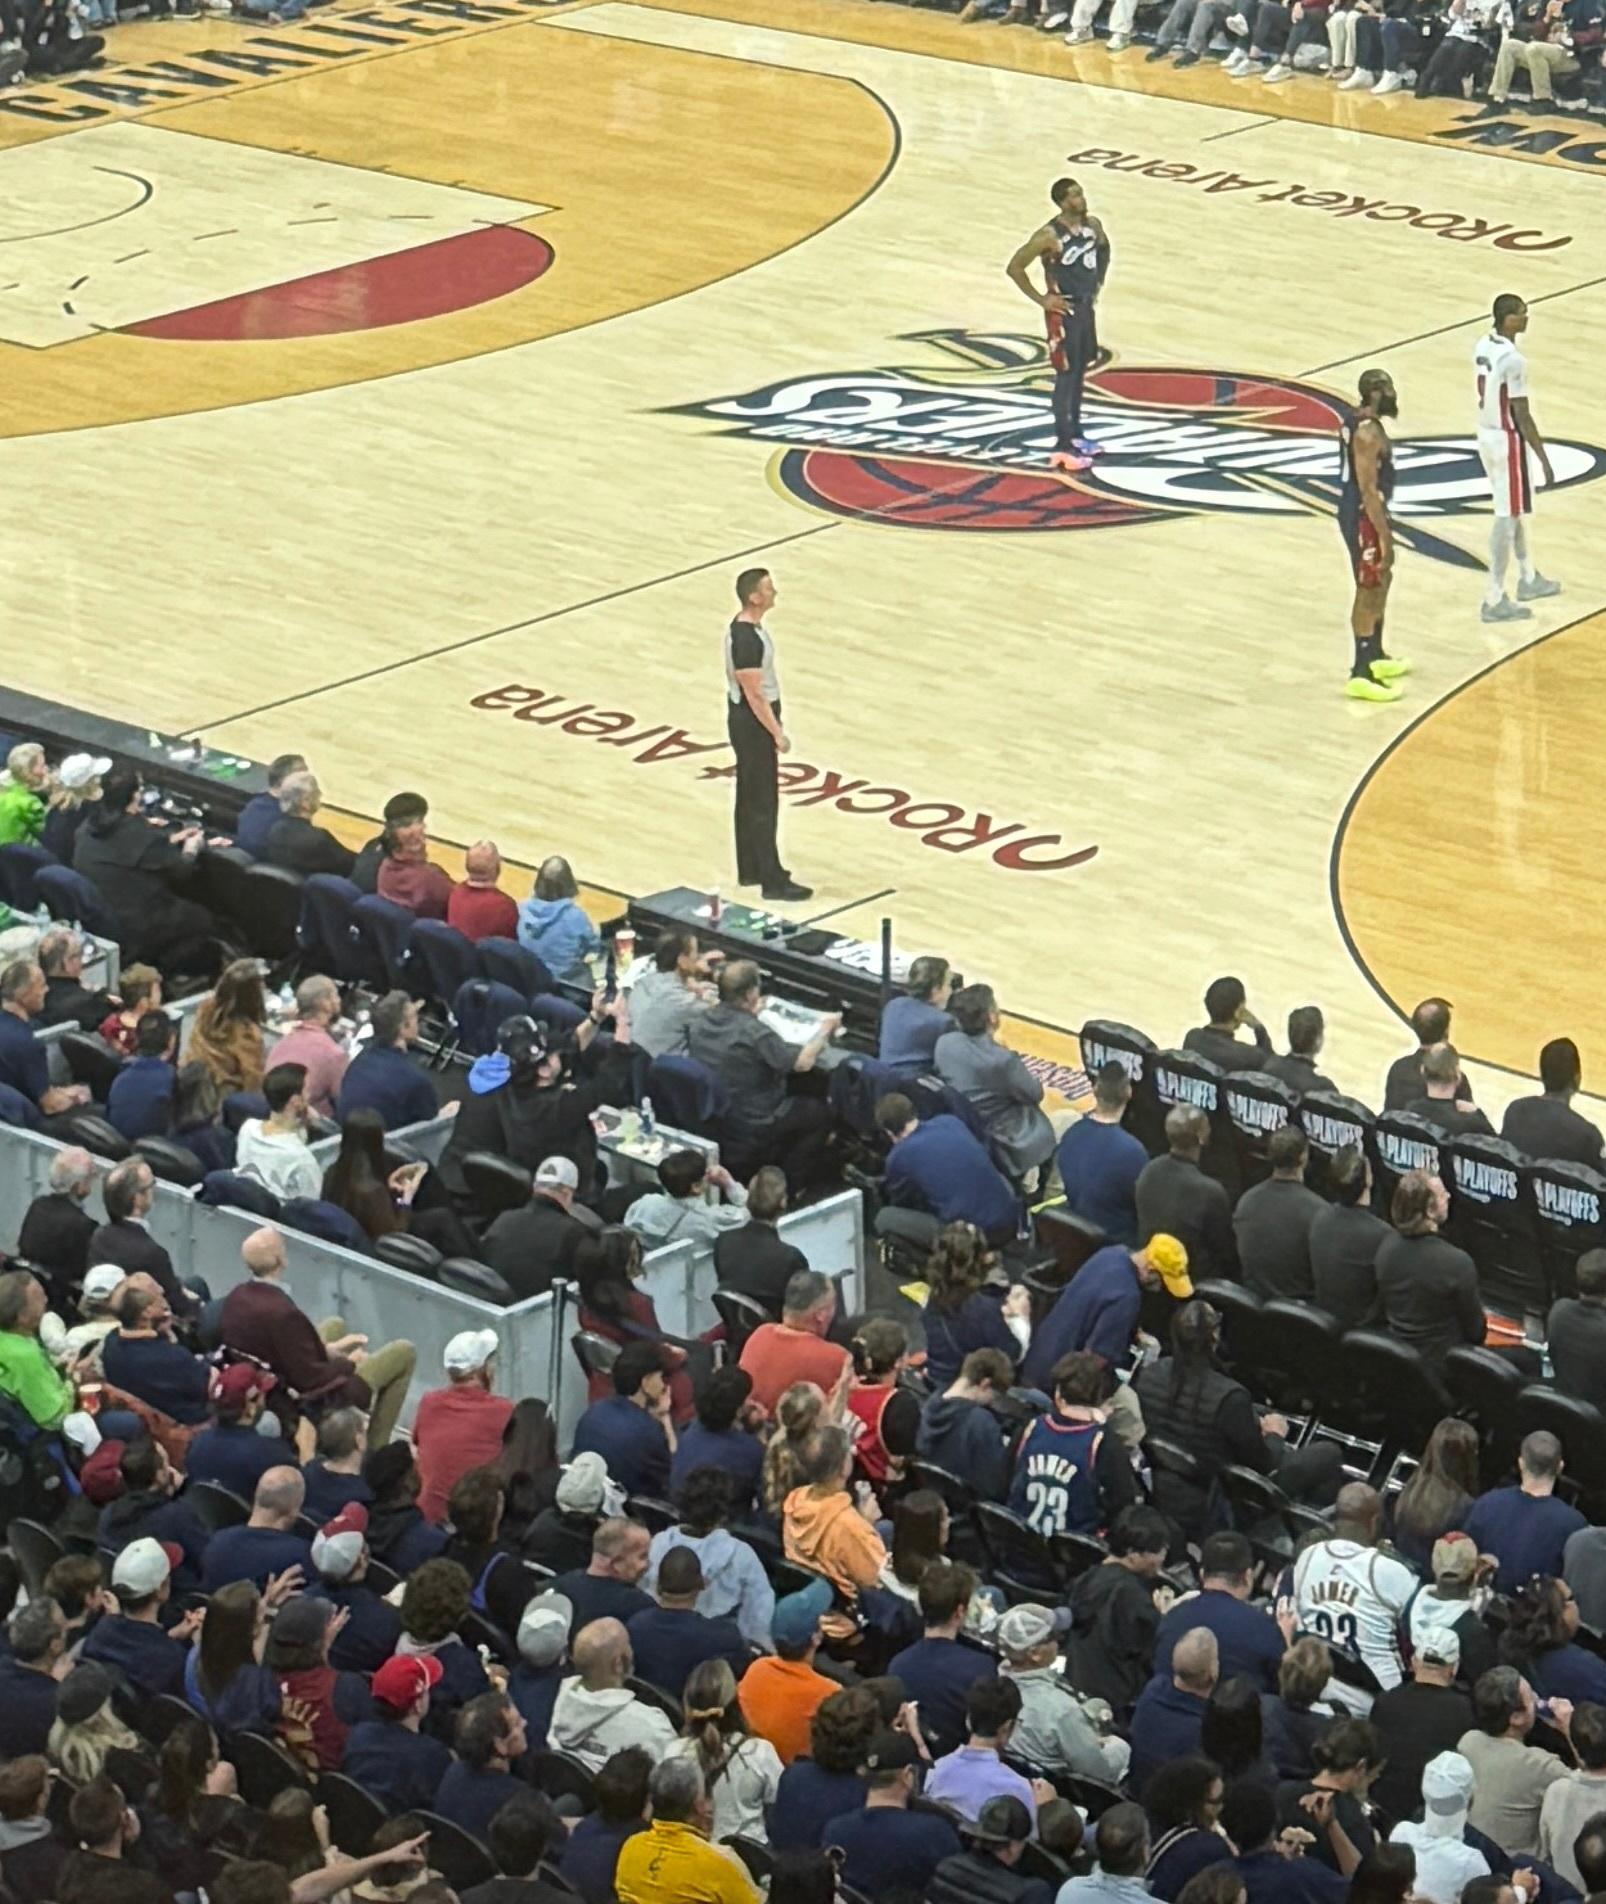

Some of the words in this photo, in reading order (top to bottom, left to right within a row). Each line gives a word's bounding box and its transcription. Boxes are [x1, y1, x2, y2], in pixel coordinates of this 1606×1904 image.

[1066, 146, 1258, 206] Arena
[1258, 188, 1504, 248] Rocket
[470, 683, 730, 765] Arena
[1027, 1453, 1078, 1484] JAMES
[1026, 1481, 1069, 1538] 23
